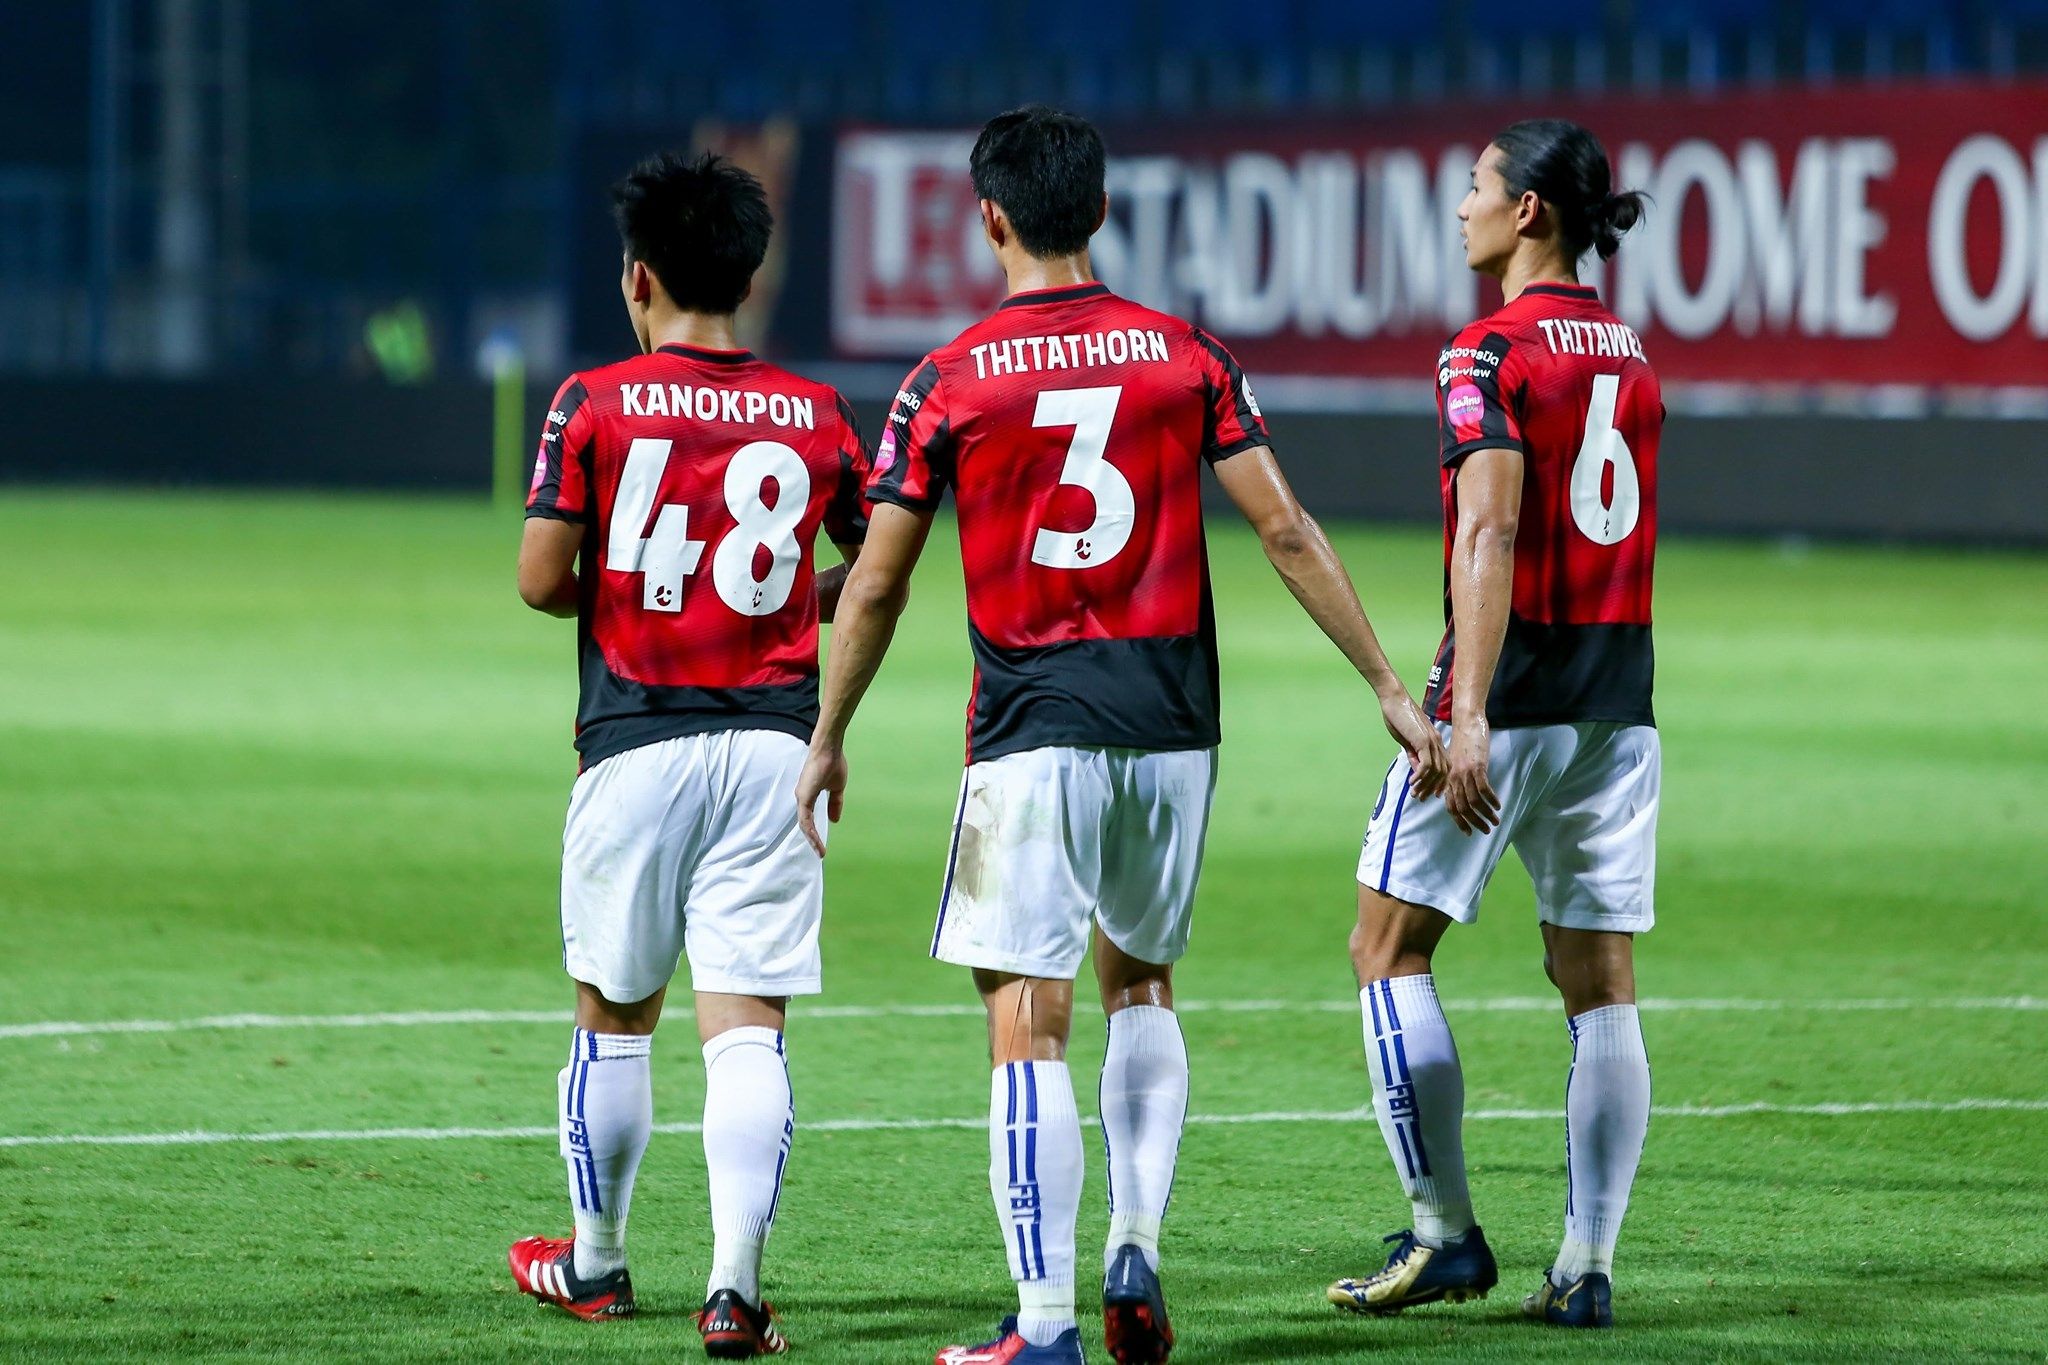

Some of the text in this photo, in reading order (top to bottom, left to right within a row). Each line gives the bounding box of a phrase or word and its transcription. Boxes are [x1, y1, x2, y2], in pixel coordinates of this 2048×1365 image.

[970, 328, 1170, 380] THITATHORN
[620, 382, 815, 431] KANOKPON
[1030, 385, 1136, 569] 3
[1570, 374, 1640, 545] 6
[606, 437, 811, 617] 48
[1008, 1183, 1042, 1222] FBT
[707, 1320, 741, 1332] COPA
